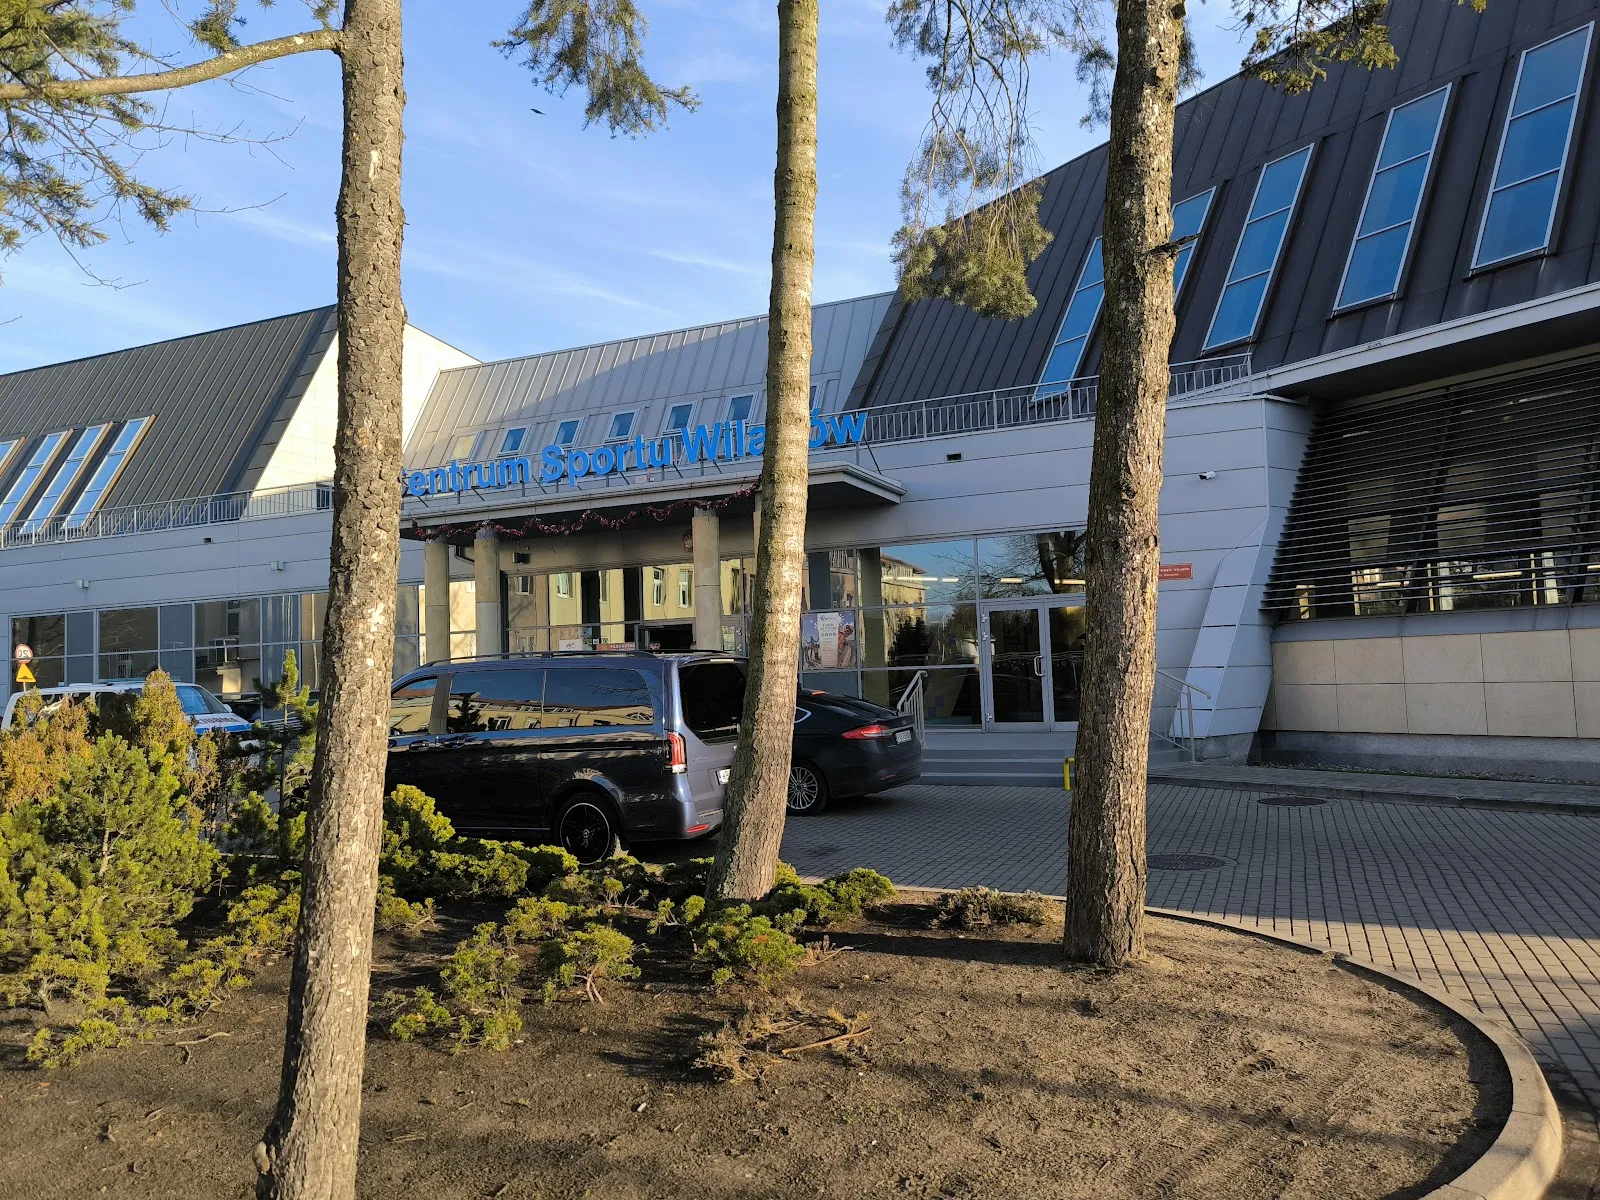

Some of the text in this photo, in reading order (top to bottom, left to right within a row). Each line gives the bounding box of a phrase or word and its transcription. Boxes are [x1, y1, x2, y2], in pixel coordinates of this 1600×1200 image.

[402, 408, 868, 497] entrum Sportu Wilaów
